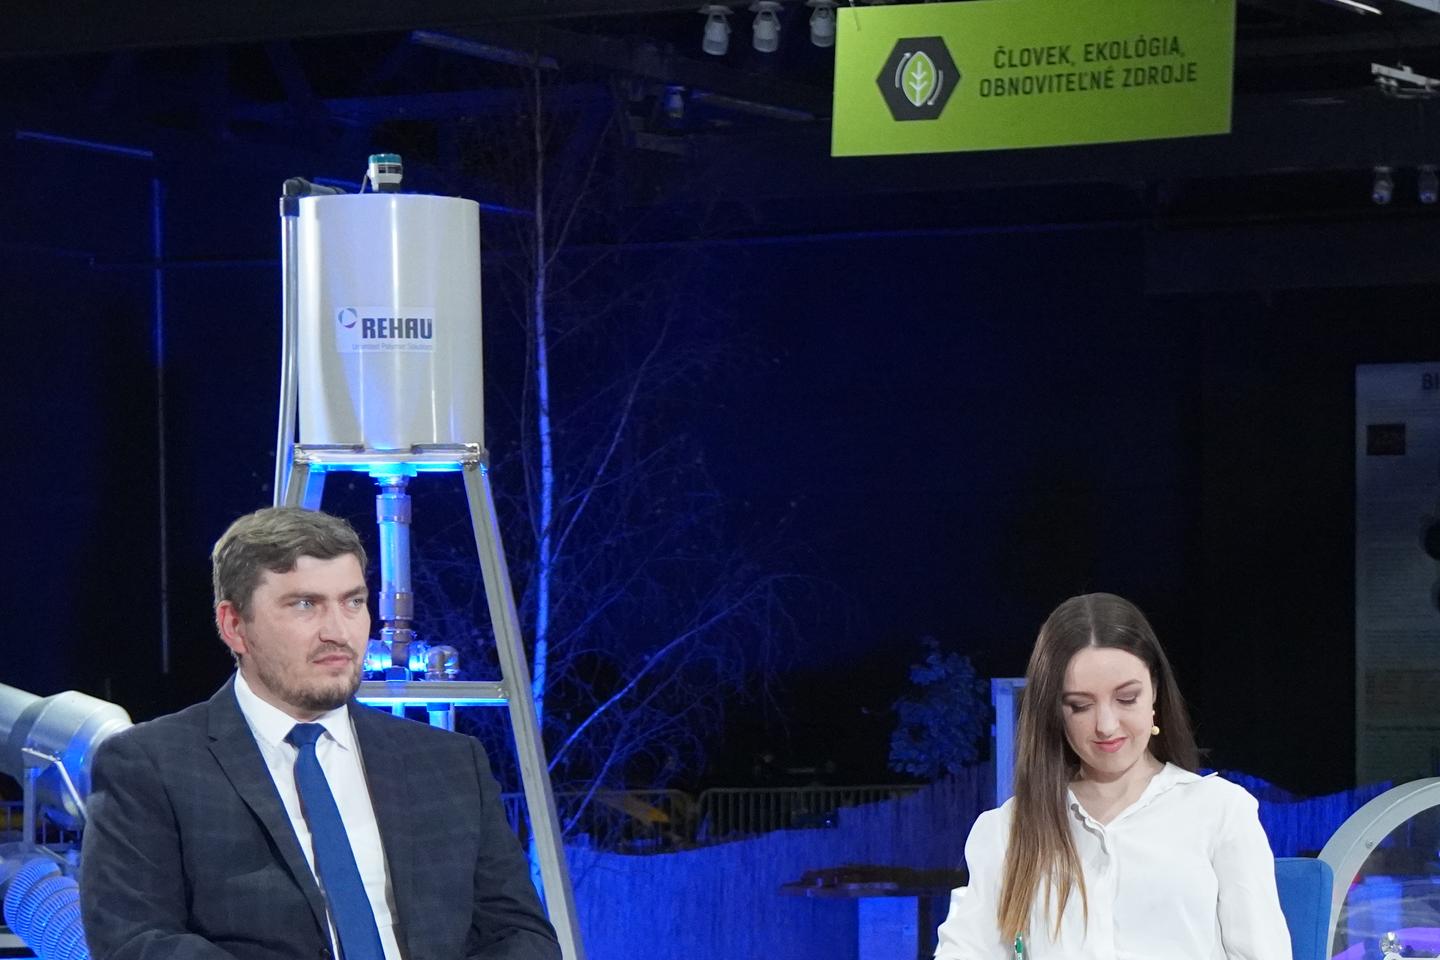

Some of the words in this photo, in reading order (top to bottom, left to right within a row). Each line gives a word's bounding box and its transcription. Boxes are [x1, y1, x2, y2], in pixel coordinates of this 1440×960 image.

[993, 45, 1075, 69] ČLOVEK,
[1083, 34, 1186, 62] EKOLÓGIA,
[979, 66, 1115, 98] OBNOVITEĽNÉ
[1121, 62, 1198, 88] ZDROJE
[362, 318, 432, 339] REHAU
